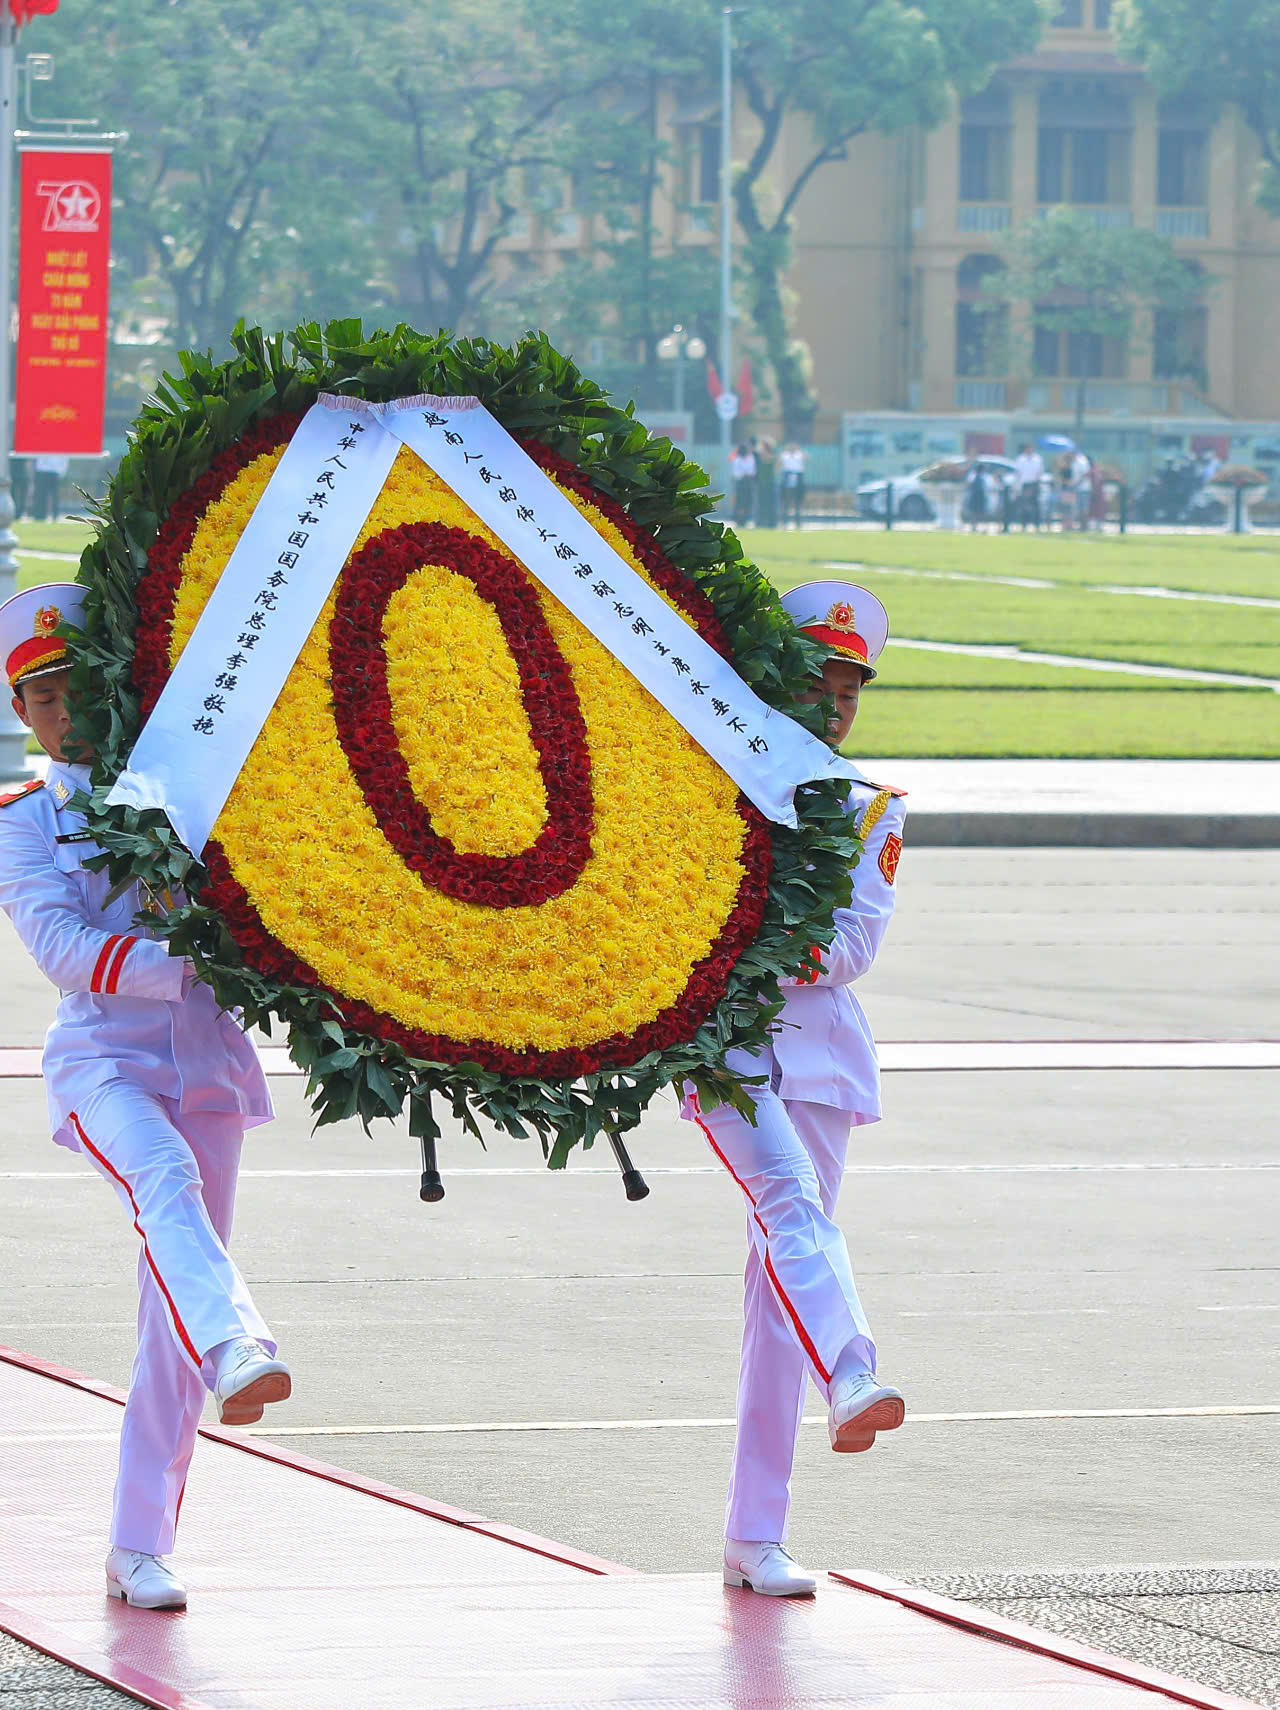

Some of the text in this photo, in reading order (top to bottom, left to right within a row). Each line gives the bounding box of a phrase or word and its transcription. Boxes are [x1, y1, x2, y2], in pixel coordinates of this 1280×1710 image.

[192, 421, 366, 736] 中华人民共和国国务院总理李强敬挽
